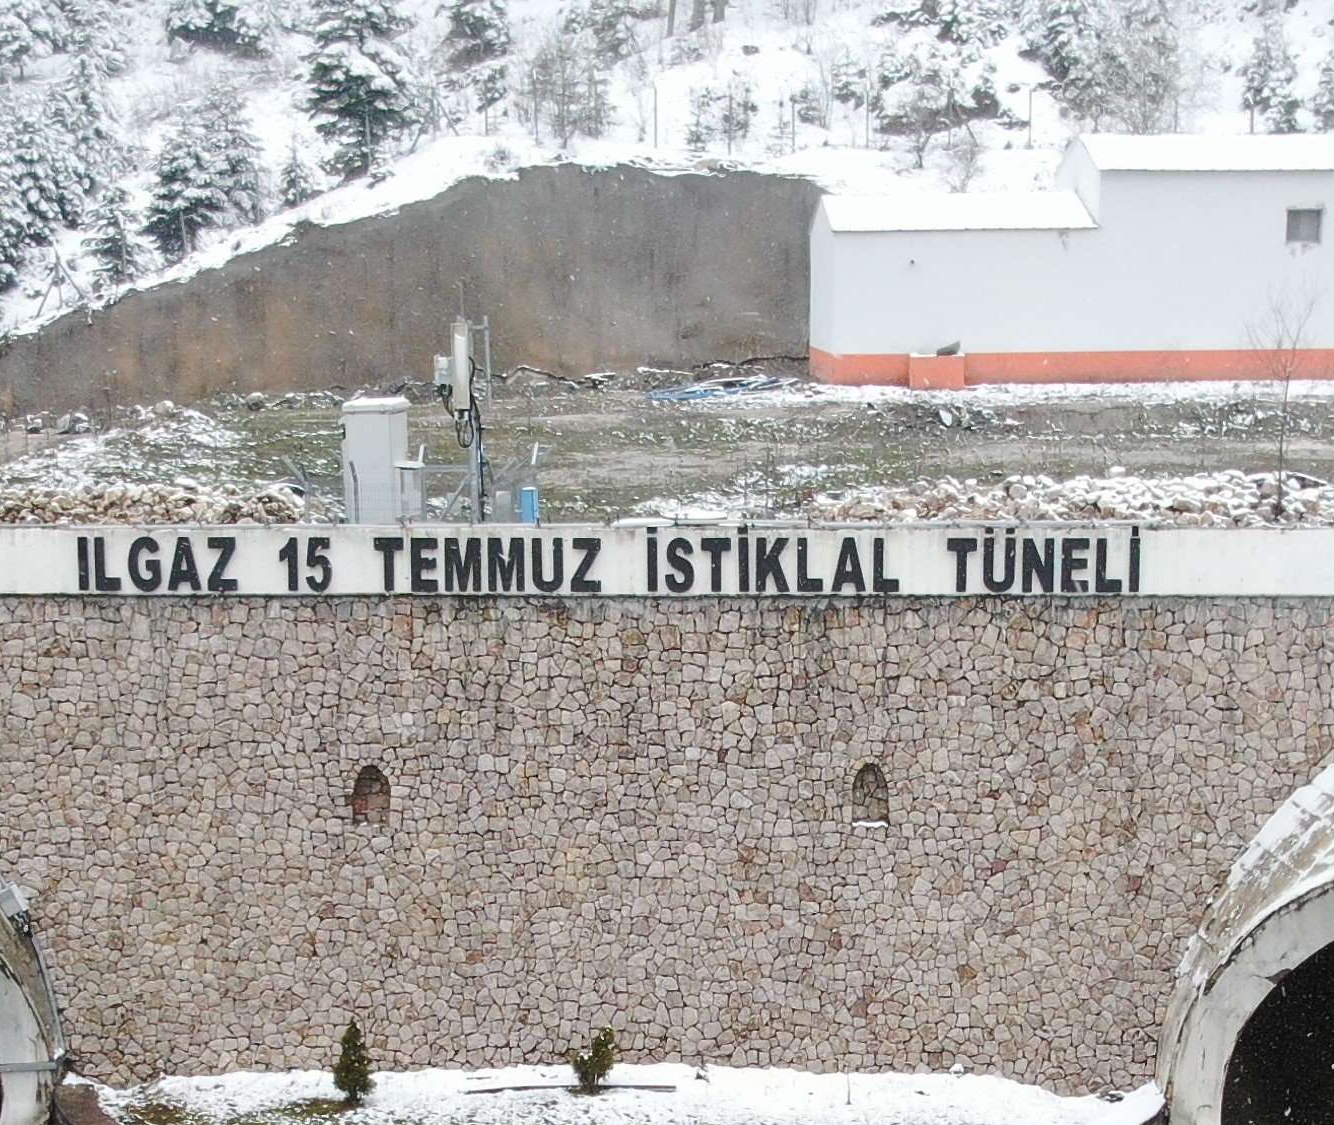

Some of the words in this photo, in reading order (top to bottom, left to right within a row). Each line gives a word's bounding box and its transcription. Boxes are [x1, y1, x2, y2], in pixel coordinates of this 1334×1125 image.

[77, 536, 238, 593] ILGAZ
[279, 536, 332, 593] 15
[373, 536, 602, 593] TEMMUZ
[646, 525, 900, 593] İSTİKLAL
[946, 525, 1141, 593] TÜNELİ
